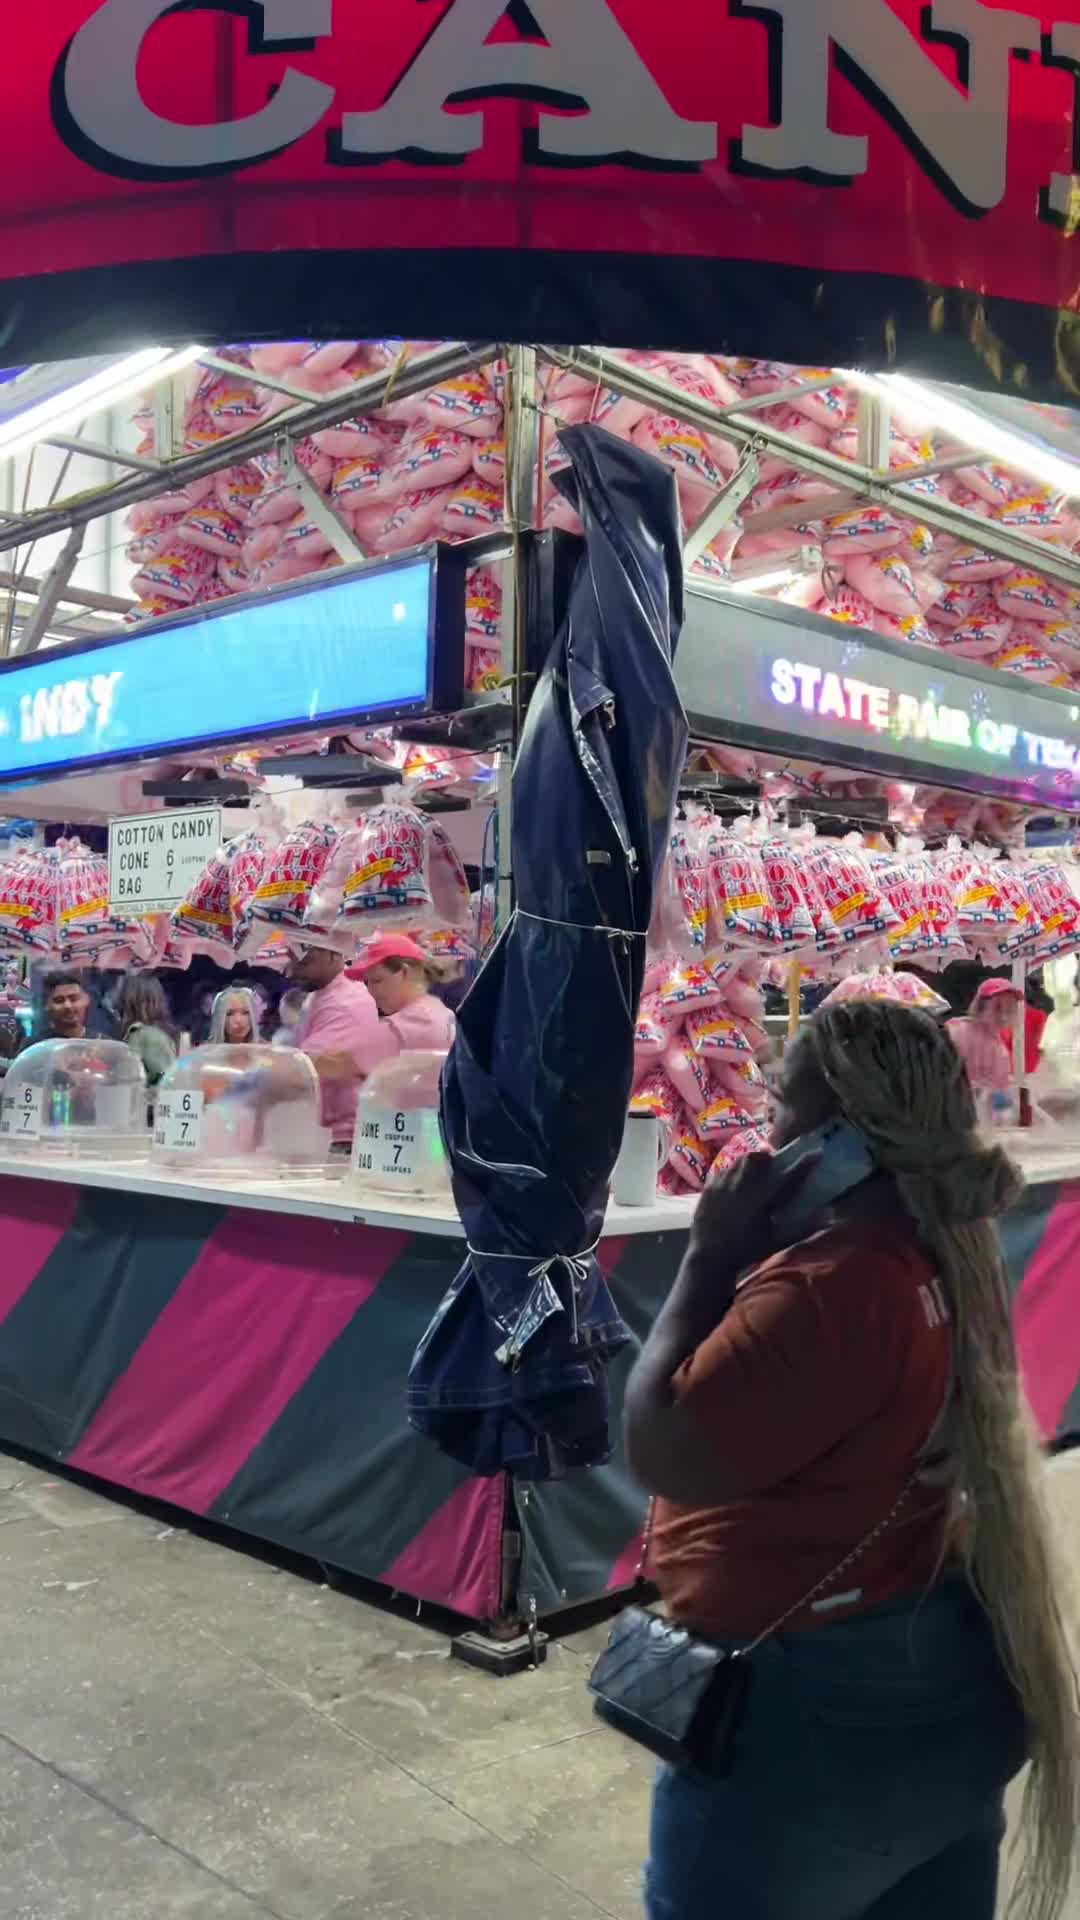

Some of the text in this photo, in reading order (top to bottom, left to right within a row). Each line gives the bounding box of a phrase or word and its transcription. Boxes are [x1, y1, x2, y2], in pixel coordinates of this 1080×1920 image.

[58, 0, 1080, 216] CAN
[771, 658, 889, 731] STATE
[117, 817, 214, 846] COTTON CANDY
[120, 851, 149, 870] CONE
[166, 849, 174, 867] 6
[118, 876, 142, 895] BAG
[167, 871, 174, 889] 7
[25, 1087, 32, 1104] 6
[183, 1093, 191, 1112] 6
[23, 1112, 31, 1129] 7
[181, 1122, 189, 1139] 7
[394, 1111, 406, 1132] 6
[393, 1144, 403, 1165] 7
